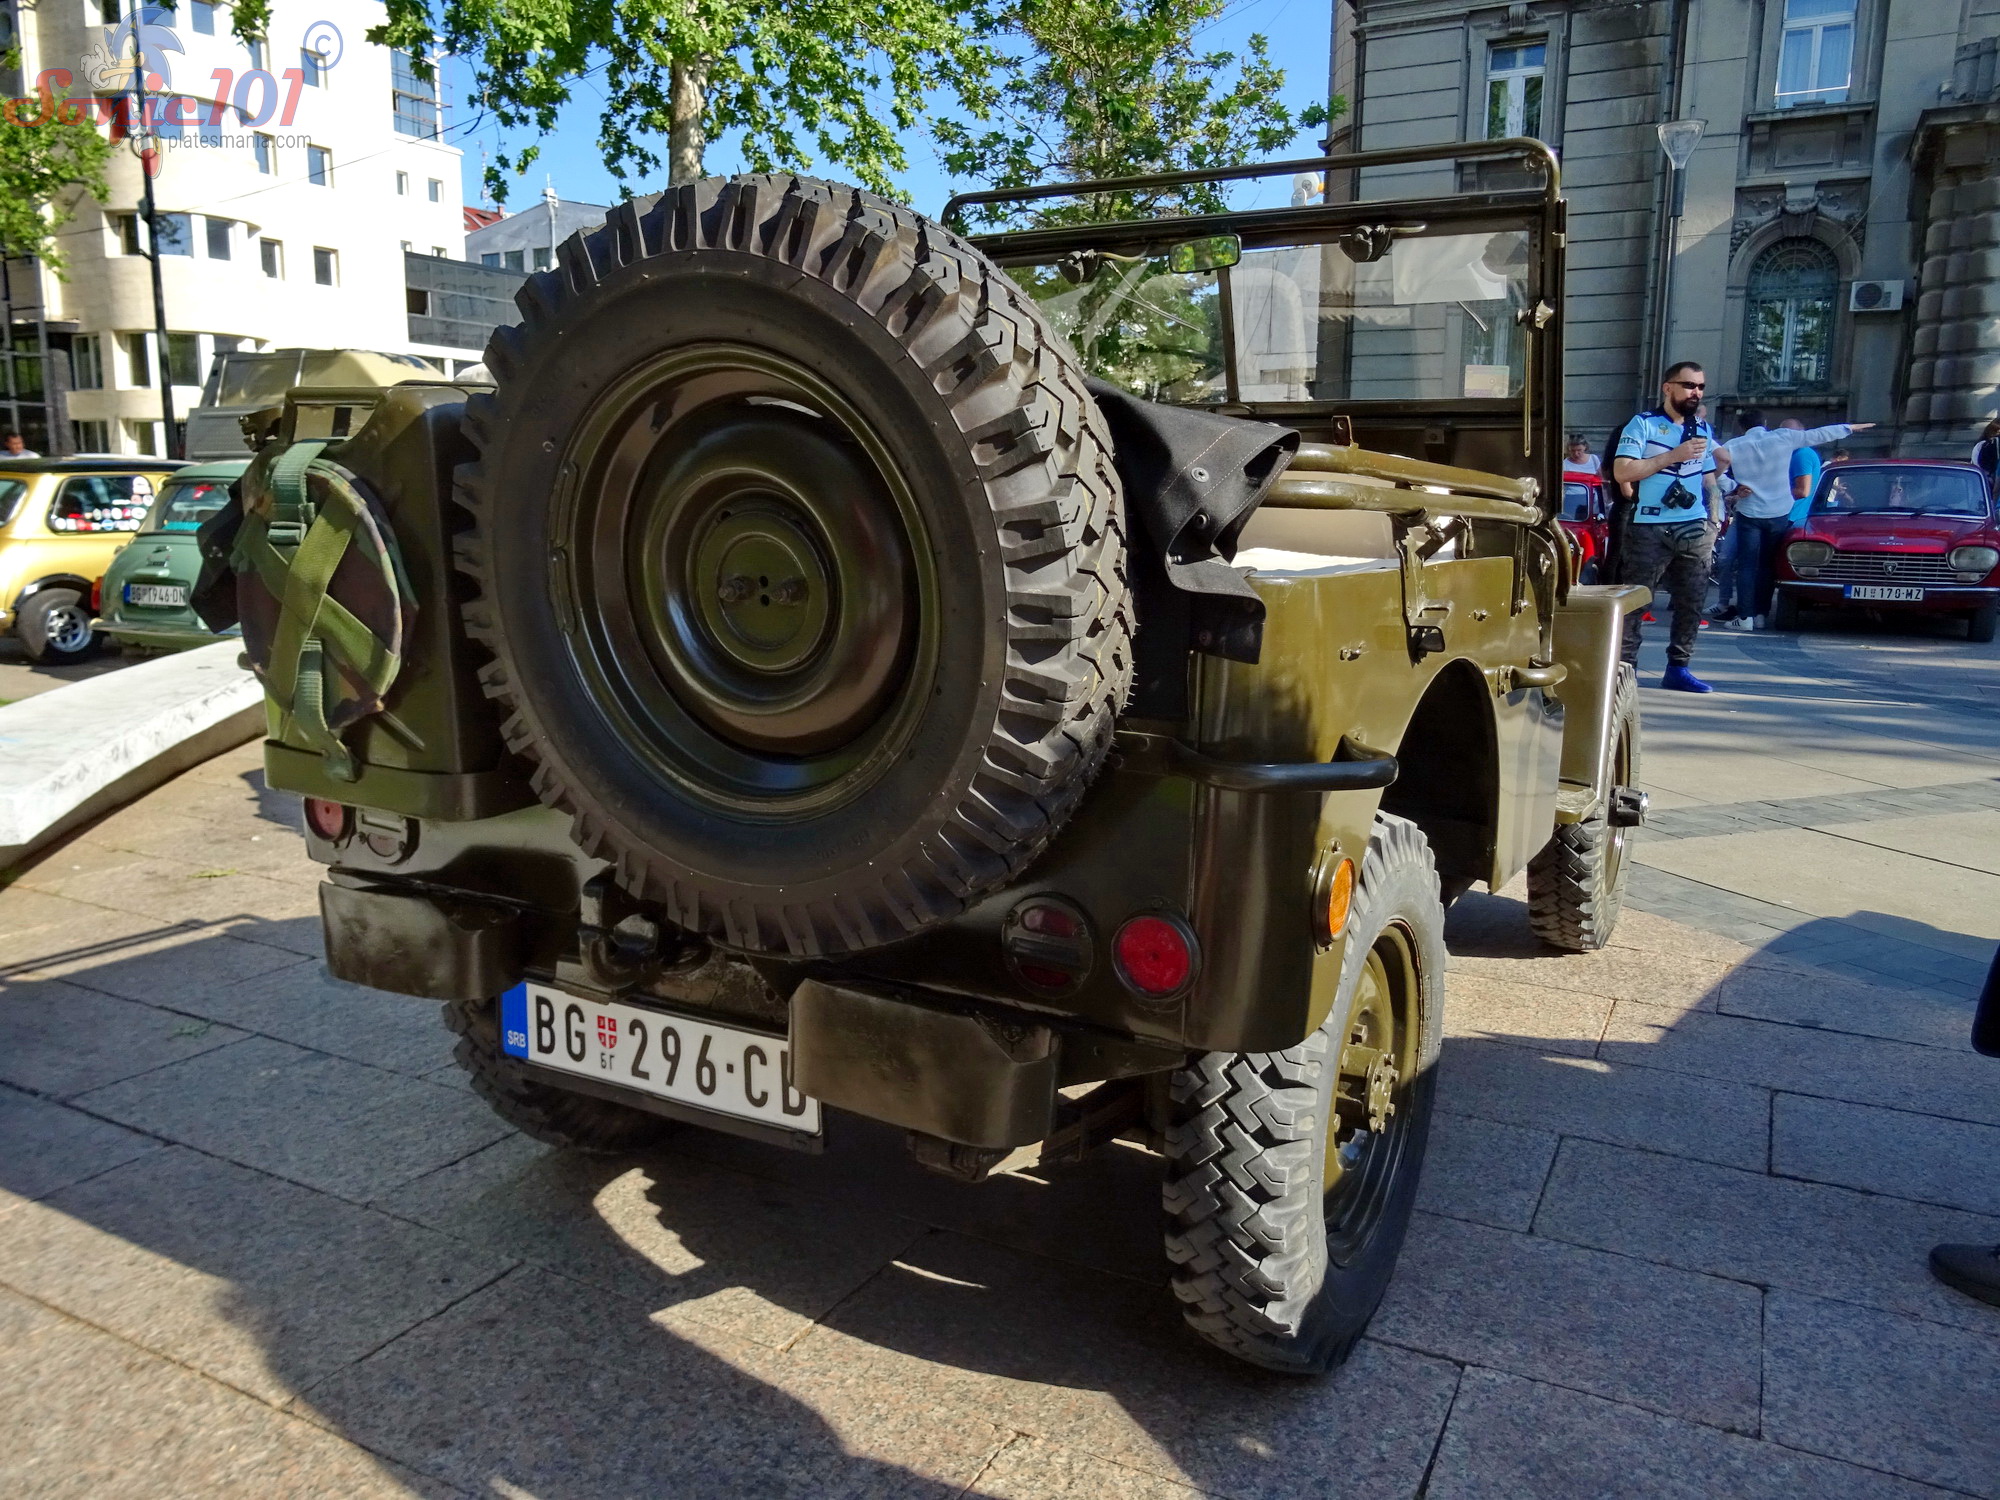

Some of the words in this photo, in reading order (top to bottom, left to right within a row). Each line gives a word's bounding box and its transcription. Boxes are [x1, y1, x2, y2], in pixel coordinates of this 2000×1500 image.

[1853, 587, 1867, 598] NI
[535, 994, 587, 1062] BG
[507, 1029, 527, 1049] SRB
